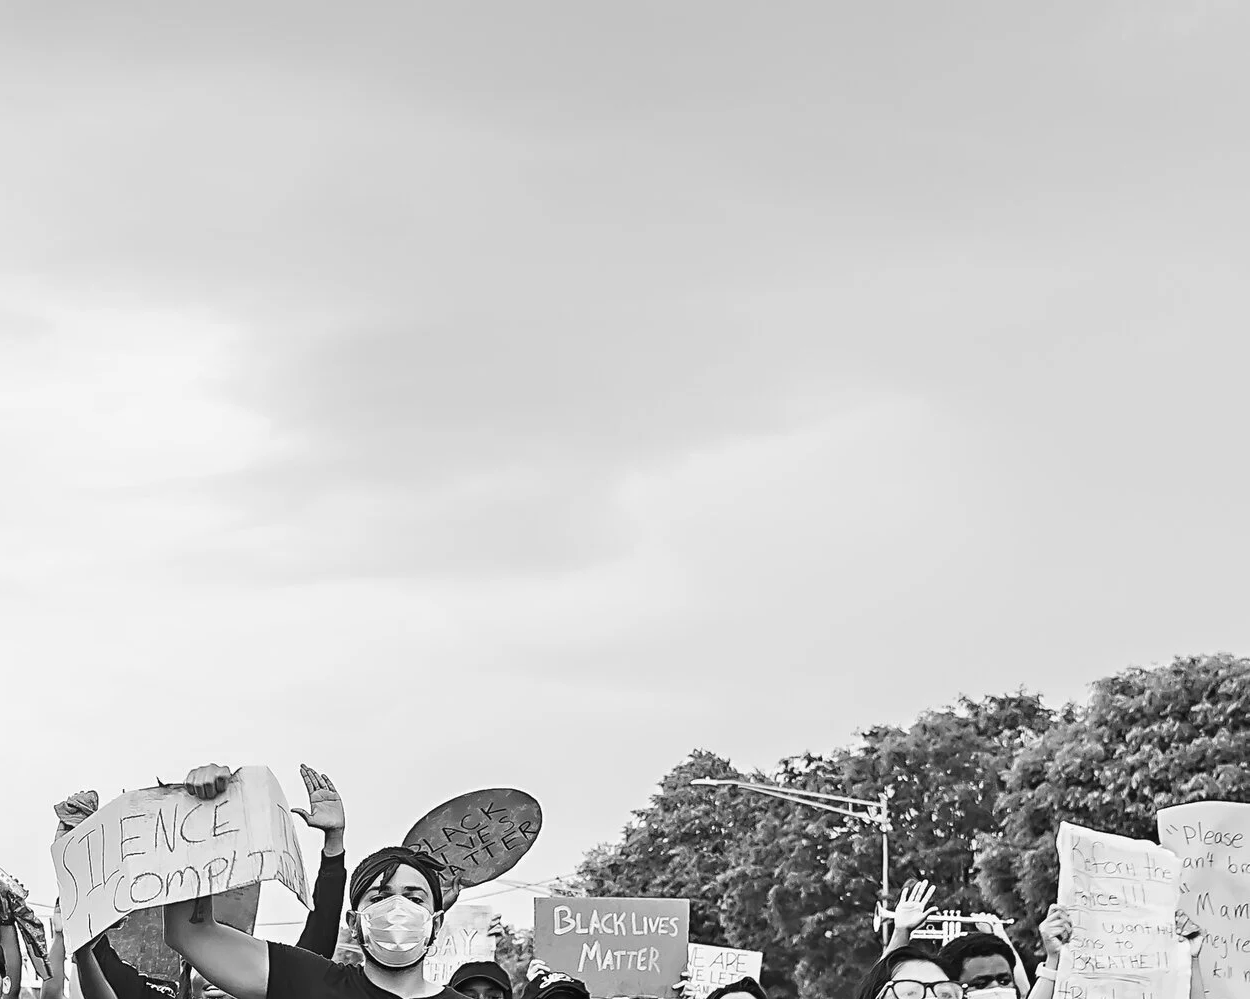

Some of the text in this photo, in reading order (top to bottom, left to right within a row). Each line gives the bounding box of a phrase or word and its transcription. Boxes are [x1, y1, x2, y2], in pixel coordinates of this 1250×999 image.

[62, 800, 240, 921] SILENCE
[437, 820, 538, 881] ATTER
[439, 815, 515, 865] IVES
[553, 904, 680, 938] BLACK LIVES
[577, 940, 662, 974] MATTER
